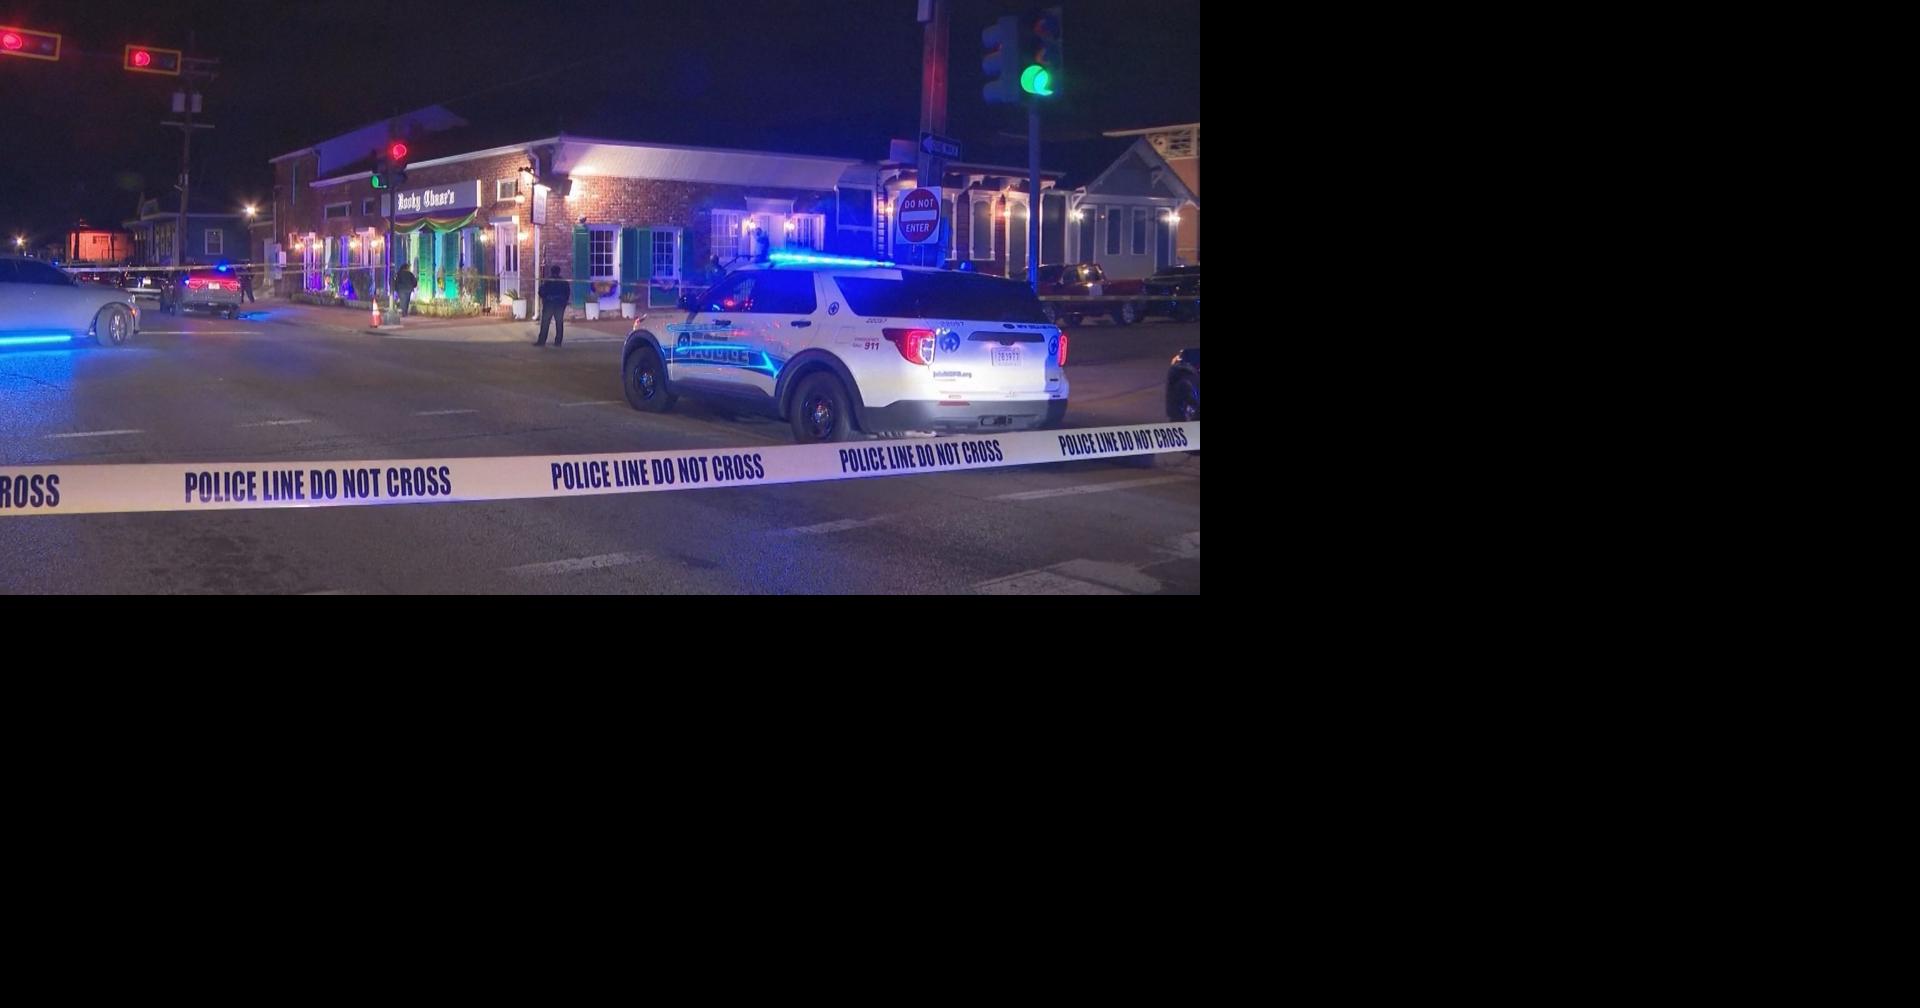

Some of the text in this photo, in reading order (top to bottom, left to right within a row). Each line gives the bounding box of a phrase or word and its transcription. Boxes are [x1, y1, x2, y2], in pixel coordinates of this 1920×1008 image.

[904, 199, 934, 209] DO NOT
[905, 223, 930, 233] ENTER
[864, 342, 880, 351] 911
[839, 439, 1003, 473] POLICE LINE DO NOT CROSS
[1058, 427, 1188, 456] POLICE LINE DO NOT CROSS
[185, 466, 451, 503] POLICE LINE DO NOT CROSS
[551, 453, 765, 490] POLICE LINE DO NOT CROSS
[0, 474, 60, 508] ROSS
